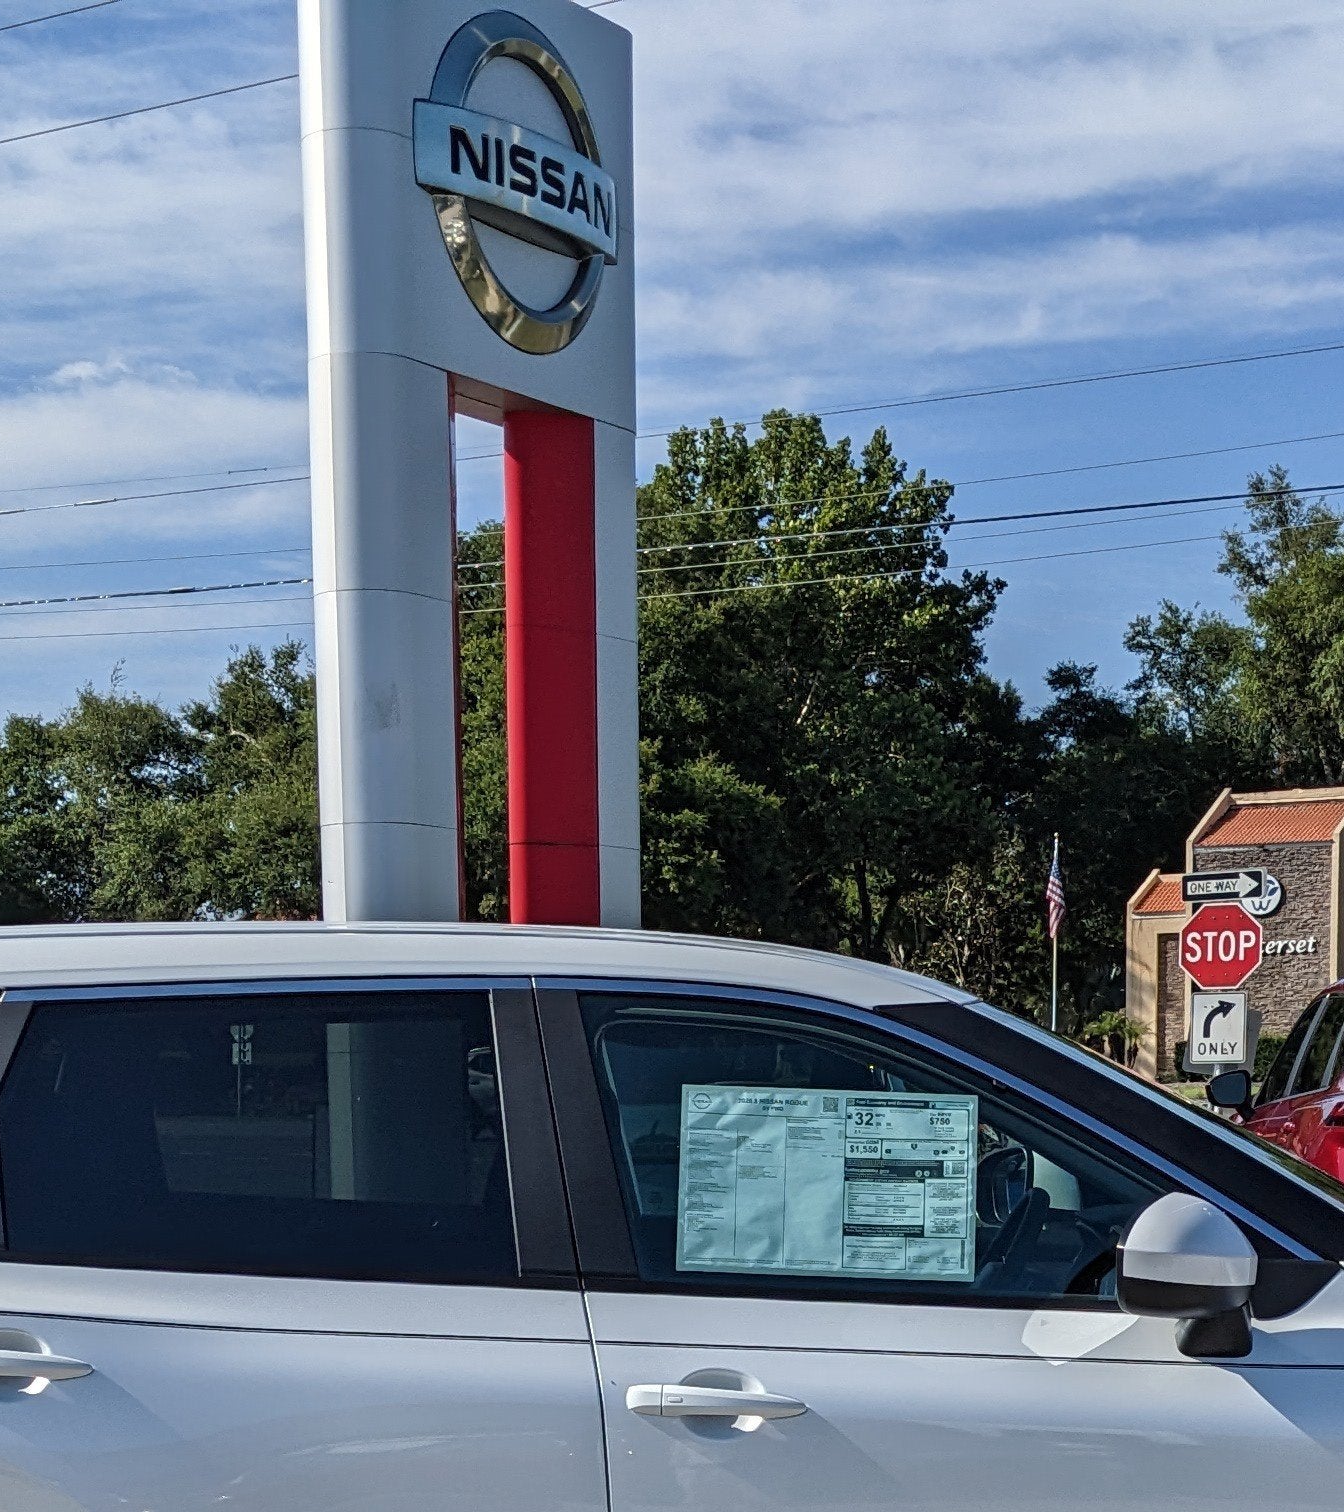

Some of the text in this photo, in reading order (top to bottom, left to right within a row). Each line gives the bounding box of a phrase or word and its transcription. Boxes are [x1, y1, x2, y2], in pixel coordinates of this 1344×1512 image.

[449, 124, 612, 238] NISSAN
[1189, 880, 1238, 894] ONE WAY
[1185, 930, 1256, 963] STOP
[1197, 1041, 1237, 1055] ONLY
[854, 1112, 874, 1126] 32
